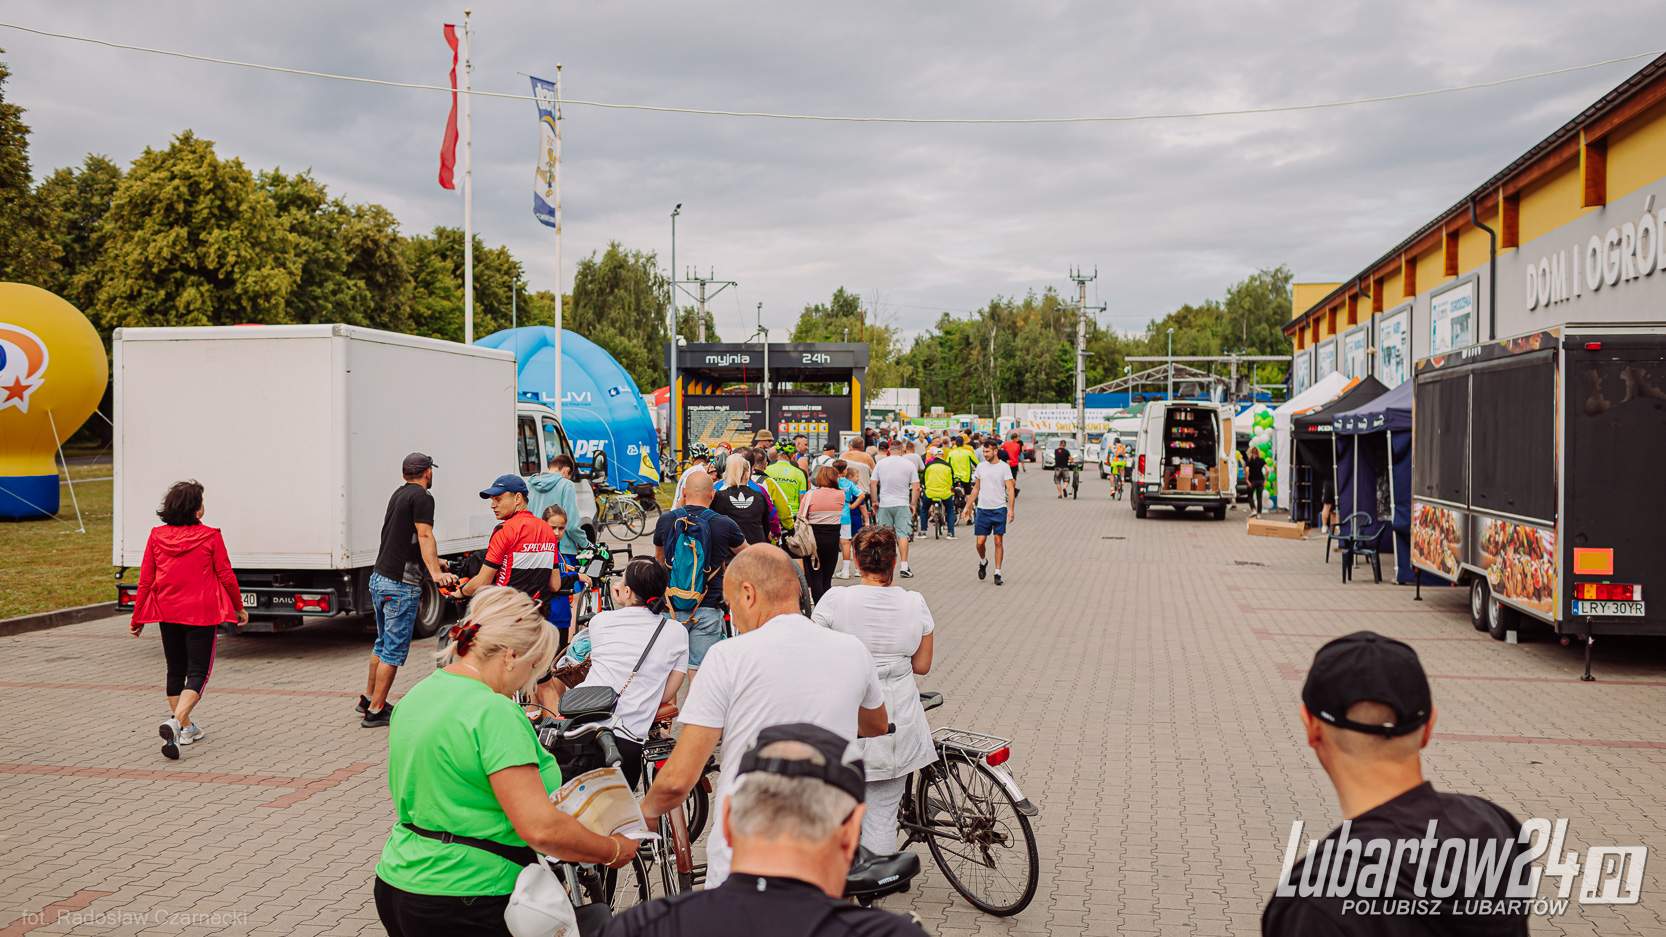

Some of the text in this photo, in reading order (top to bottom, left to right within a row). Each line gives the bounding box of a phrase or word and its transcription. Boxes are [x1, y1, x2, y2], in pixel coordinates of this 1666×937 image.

[1526, 250, 1569, 311] DOM
[1573, 243, 1582, 298] I
[705, 353, 831, 367] myjnia 24h
[1581, 602, 1643, 614] LRY 30YR
